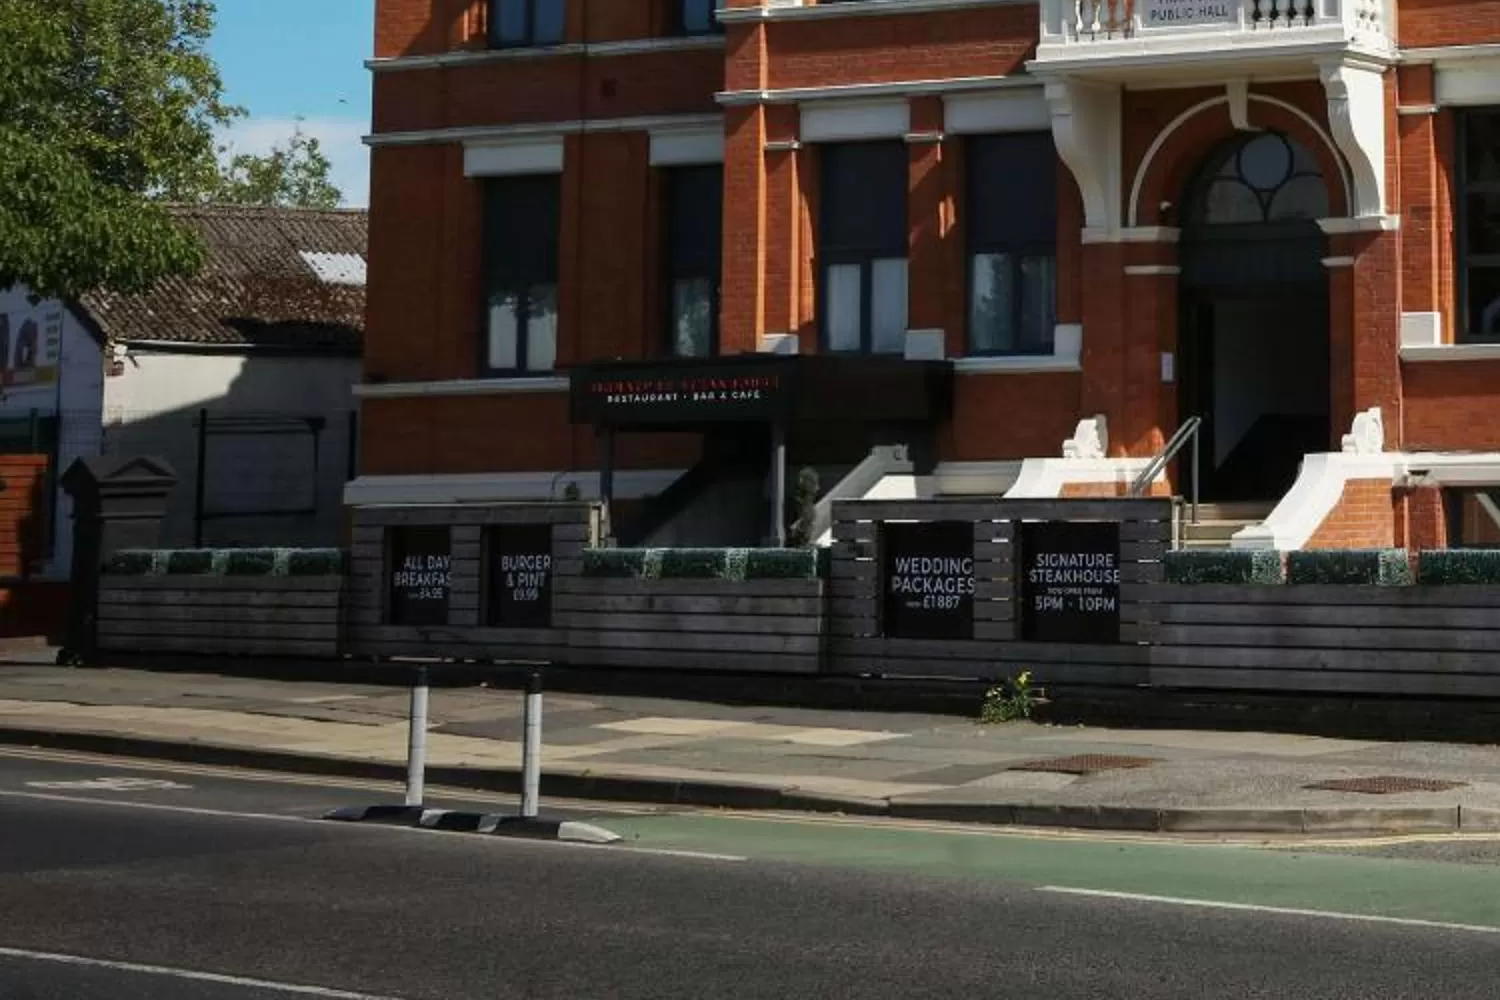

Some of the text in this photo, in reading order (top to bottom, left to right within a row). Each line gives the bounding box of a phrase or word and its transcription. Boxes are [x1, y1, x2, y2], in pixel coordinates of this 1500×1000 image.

[1151, 4, 1228, 21] PUBLIC HALL
[403, 555, 450, 569] ALL DAY
[501, 555, 551, 571] BURGER
[895, 556, 974, 575] WEDDING
[1036, 553, 1114, 568] SIGNATURE
[394, 571, 452, 587] BREAKFAS
[517, 571, 547, 587] PINT
[1029, 569, 1120, 584] STEAKHOUSE
[891, 576, 976, 595] PACKAGES
[923, 595, 961, 609] £1887
[1035, 595, 1064, 611] 5PM
[1079, 596, 1115, 611] 10PM
